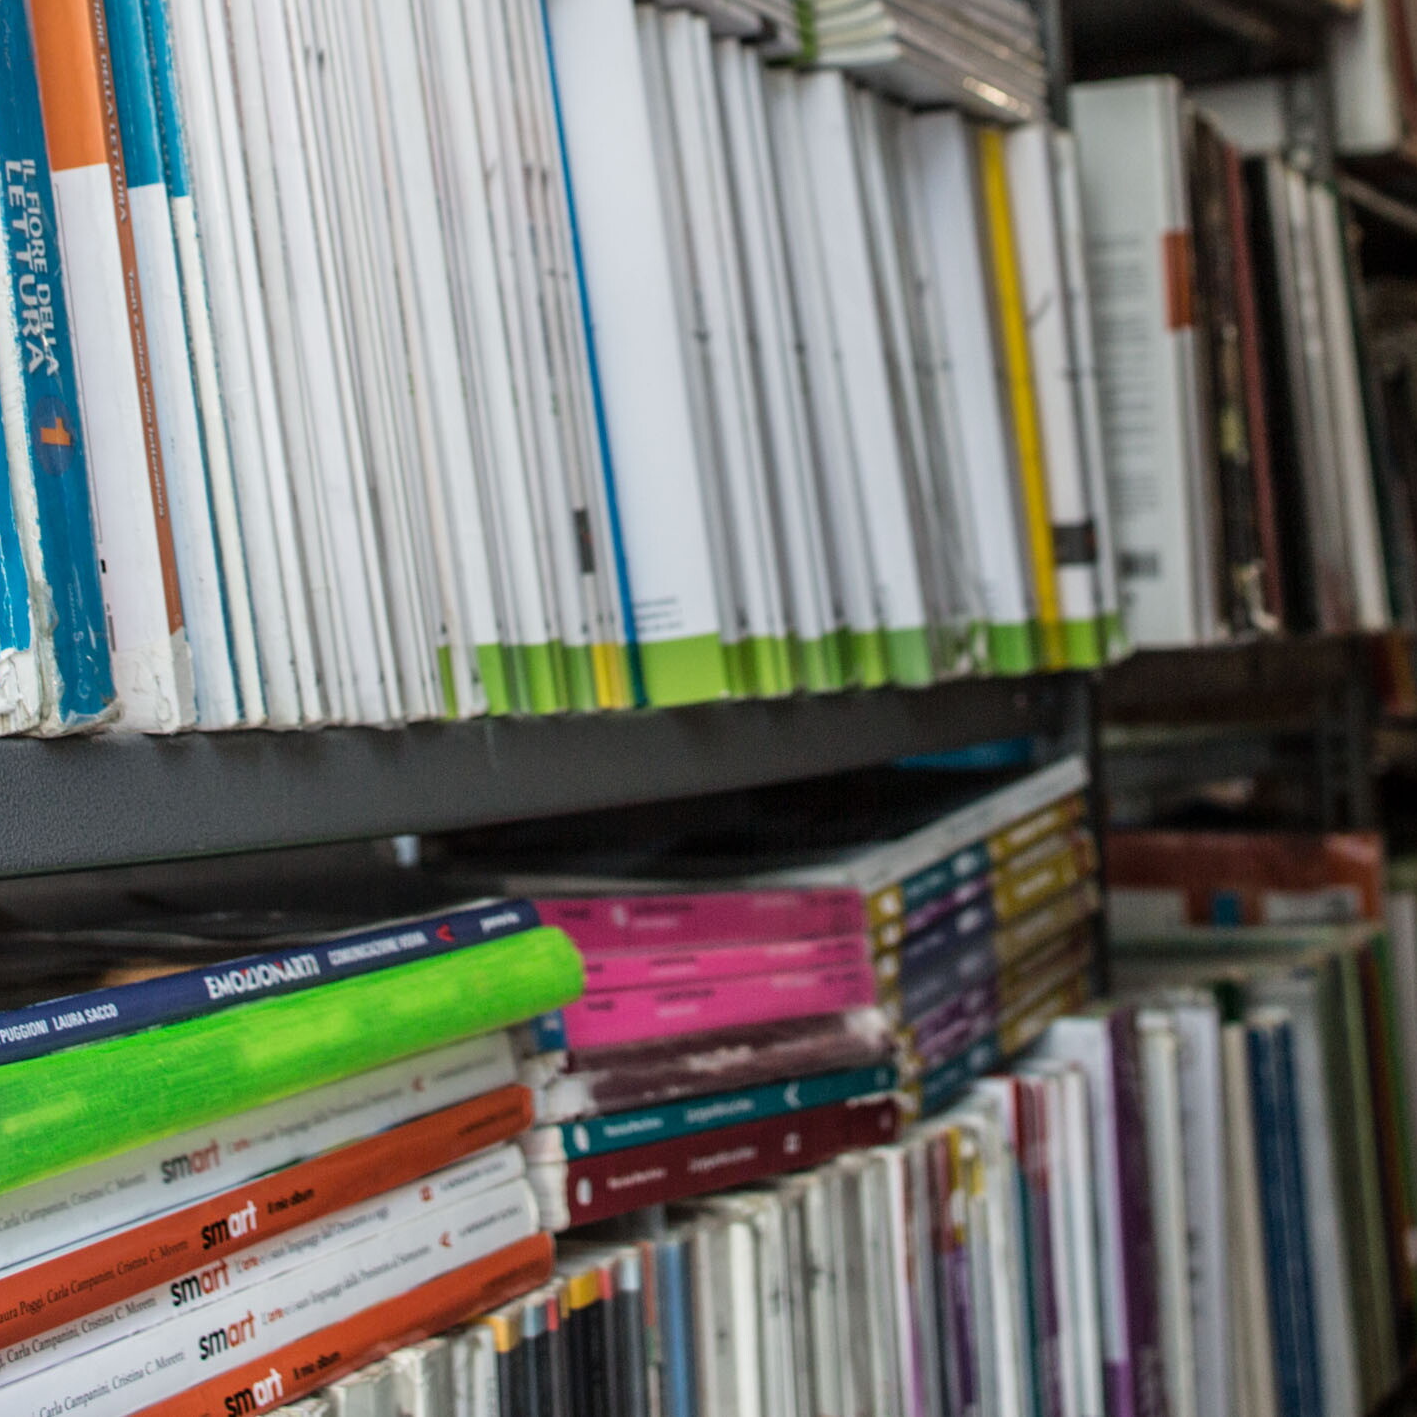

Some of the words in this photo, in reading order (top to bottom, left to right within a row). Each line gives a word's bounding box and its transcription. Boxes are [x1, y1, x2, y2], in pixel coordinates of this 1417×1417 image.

[22, 158, 37, 182] IL
[25, 191, 48, 273] FIORE
[4, 159, 44, 374] LETTURA
[36, 283, 60, 376] DELLA
[39, 417, 71, 447] 1
[0, 1019, 50, 1045] PUGGIONI
[51, 1011, 87, 1032] LAURA
[85, 1002, 118, 1025] SACCO
[160, 1139, 222, 1185] smart
[201, 1199, 258, 1251] smart
[170, 1257, 232, 1307] smart
[199, 1310, 257, 1360] smart
[224, 1367, 284, 1417] smart
